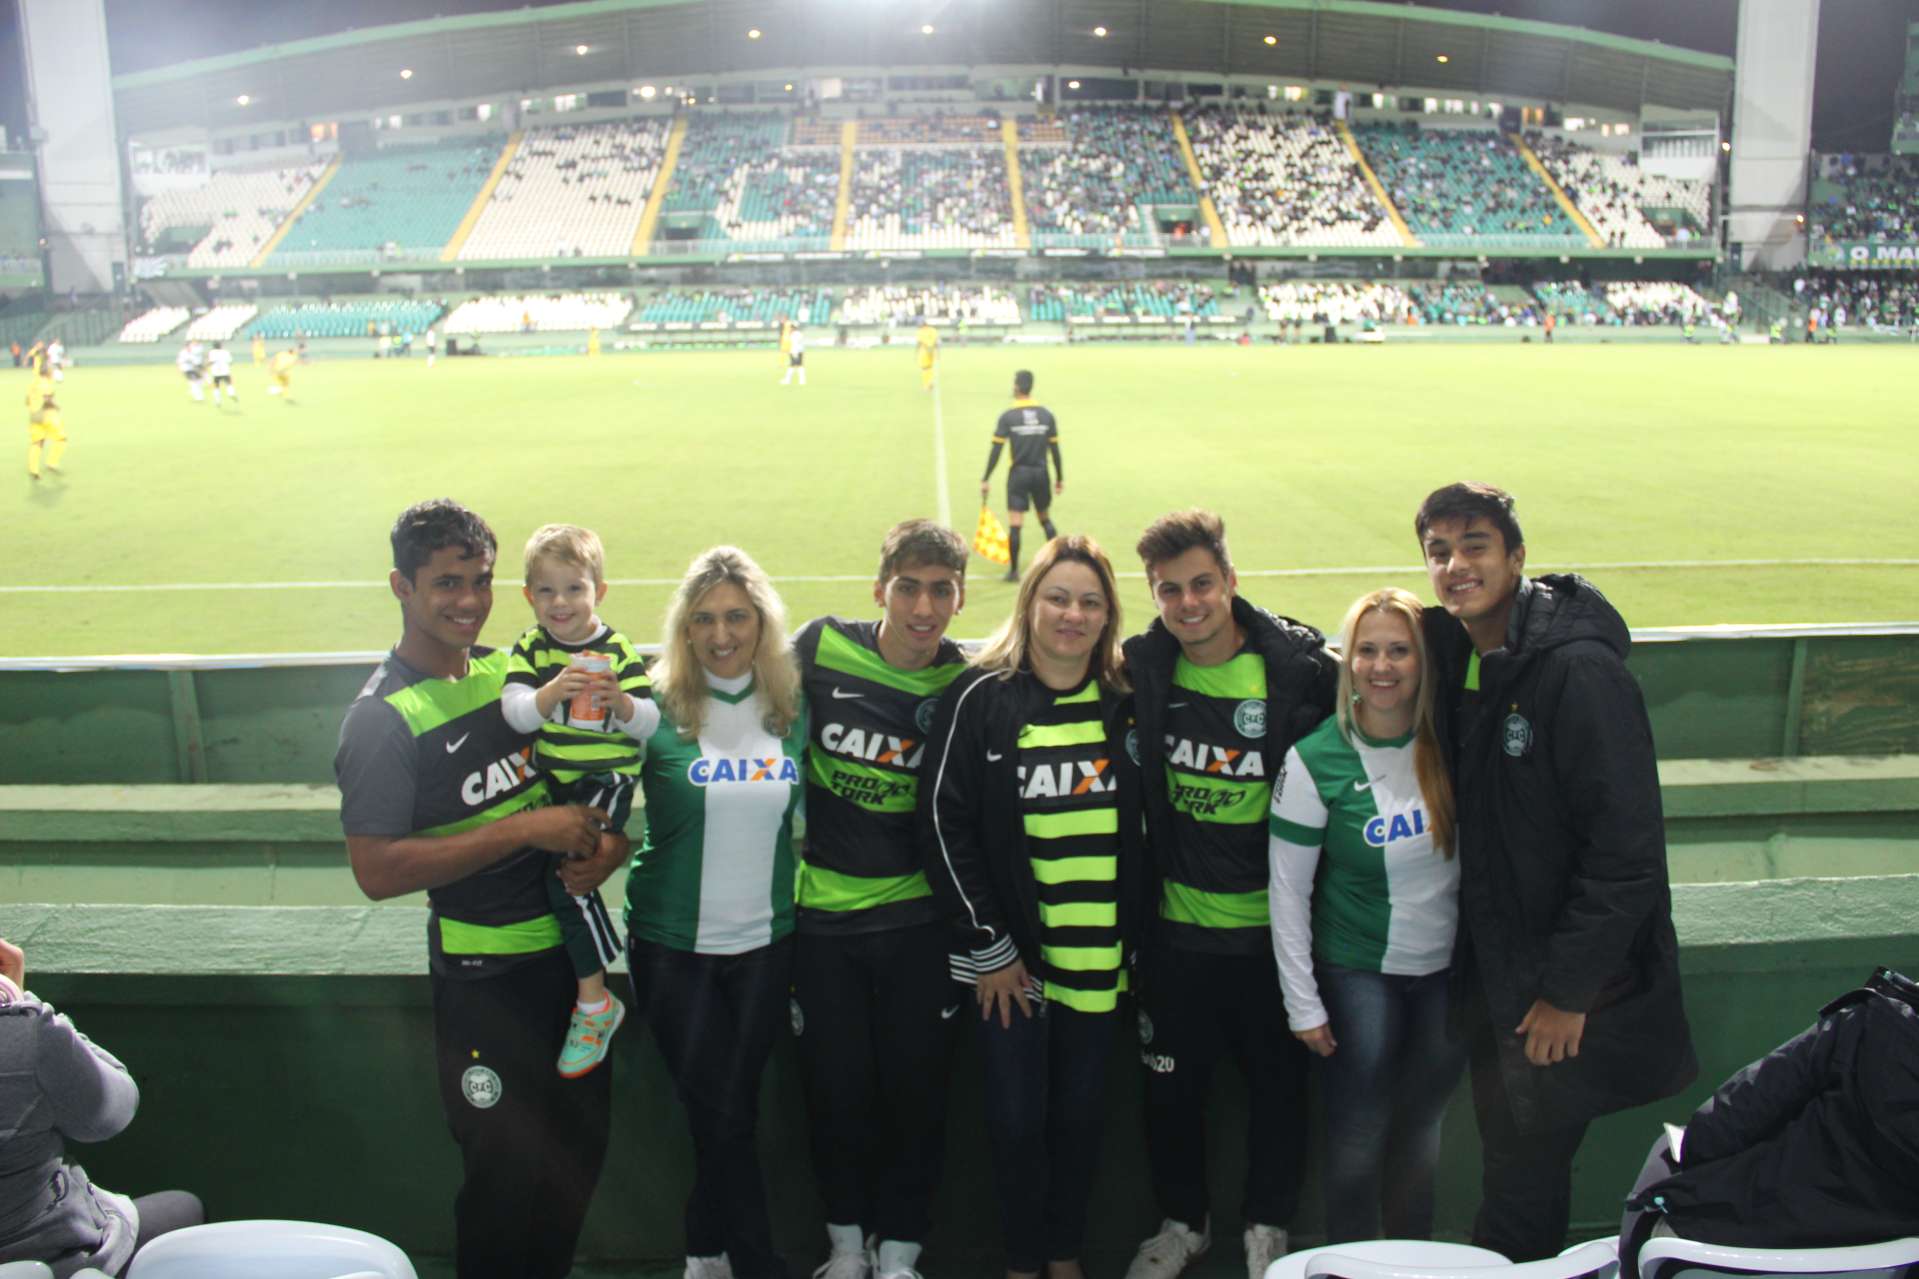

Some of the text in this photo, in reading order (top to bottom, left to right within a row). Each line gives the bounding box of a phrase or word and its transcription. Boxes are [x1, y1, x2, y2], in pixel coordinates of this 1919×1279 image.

[688, 757, 799, 786] CAIXA
[832, 770, 880, 789] PRO
[1017, 758, 1117, 799] AIX
